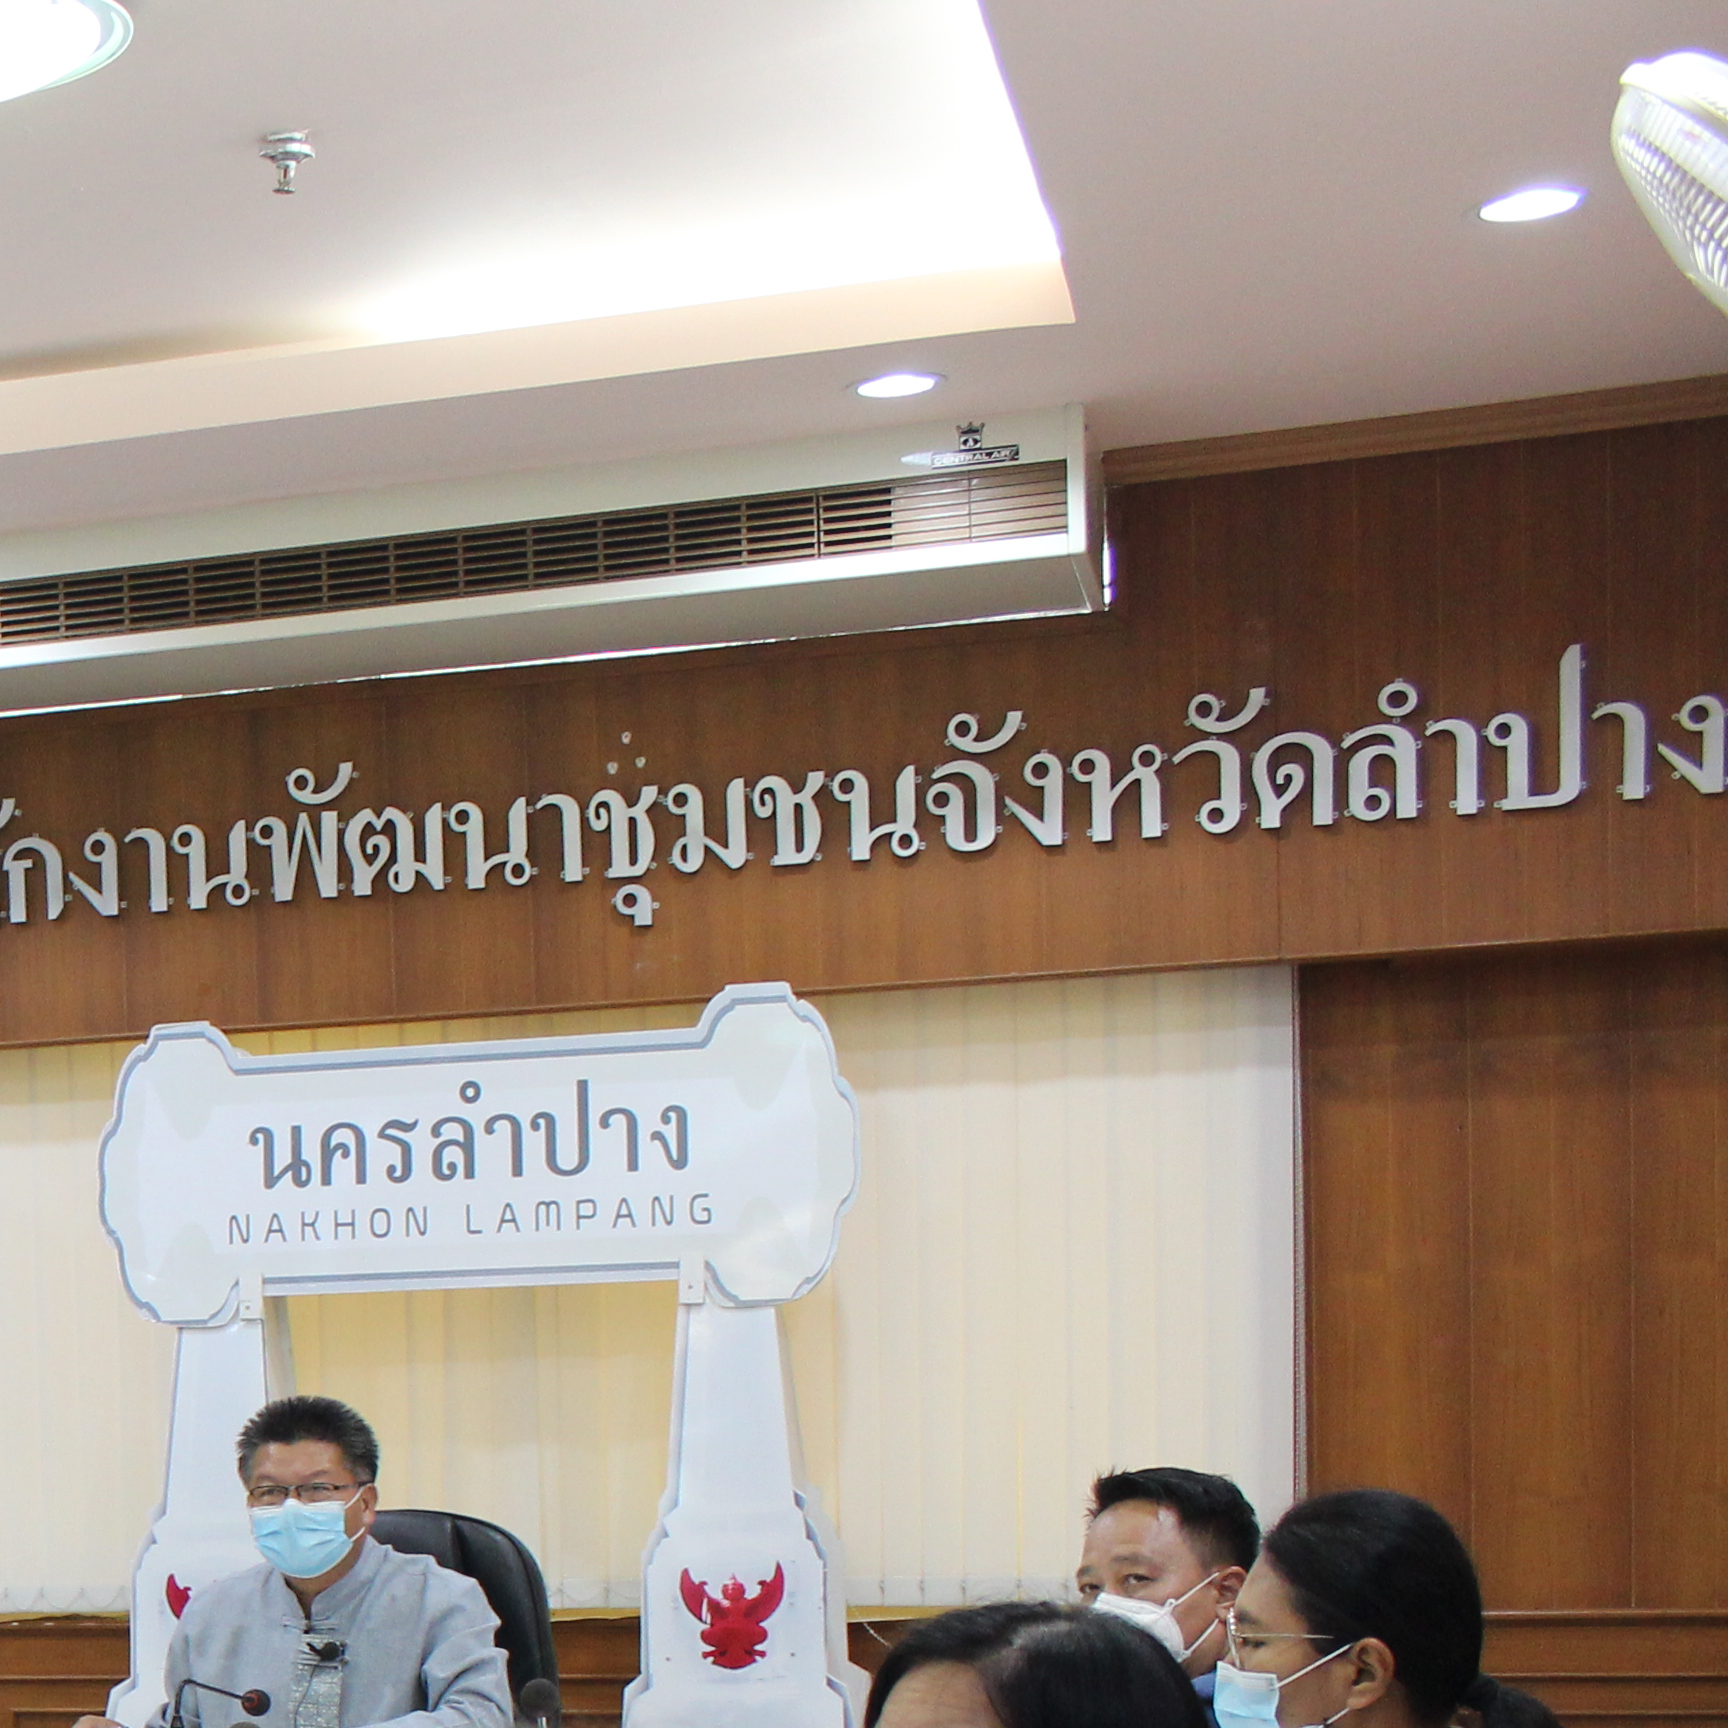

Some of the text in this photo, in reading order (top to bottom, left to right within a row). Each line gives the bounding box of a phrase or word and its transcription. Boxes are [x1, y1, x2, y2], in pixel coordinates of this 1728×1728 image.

[248, 1079, 691, 1191] นครลำปาง
[227, 1192, 717, 1246] NAKHON LAMPANG
